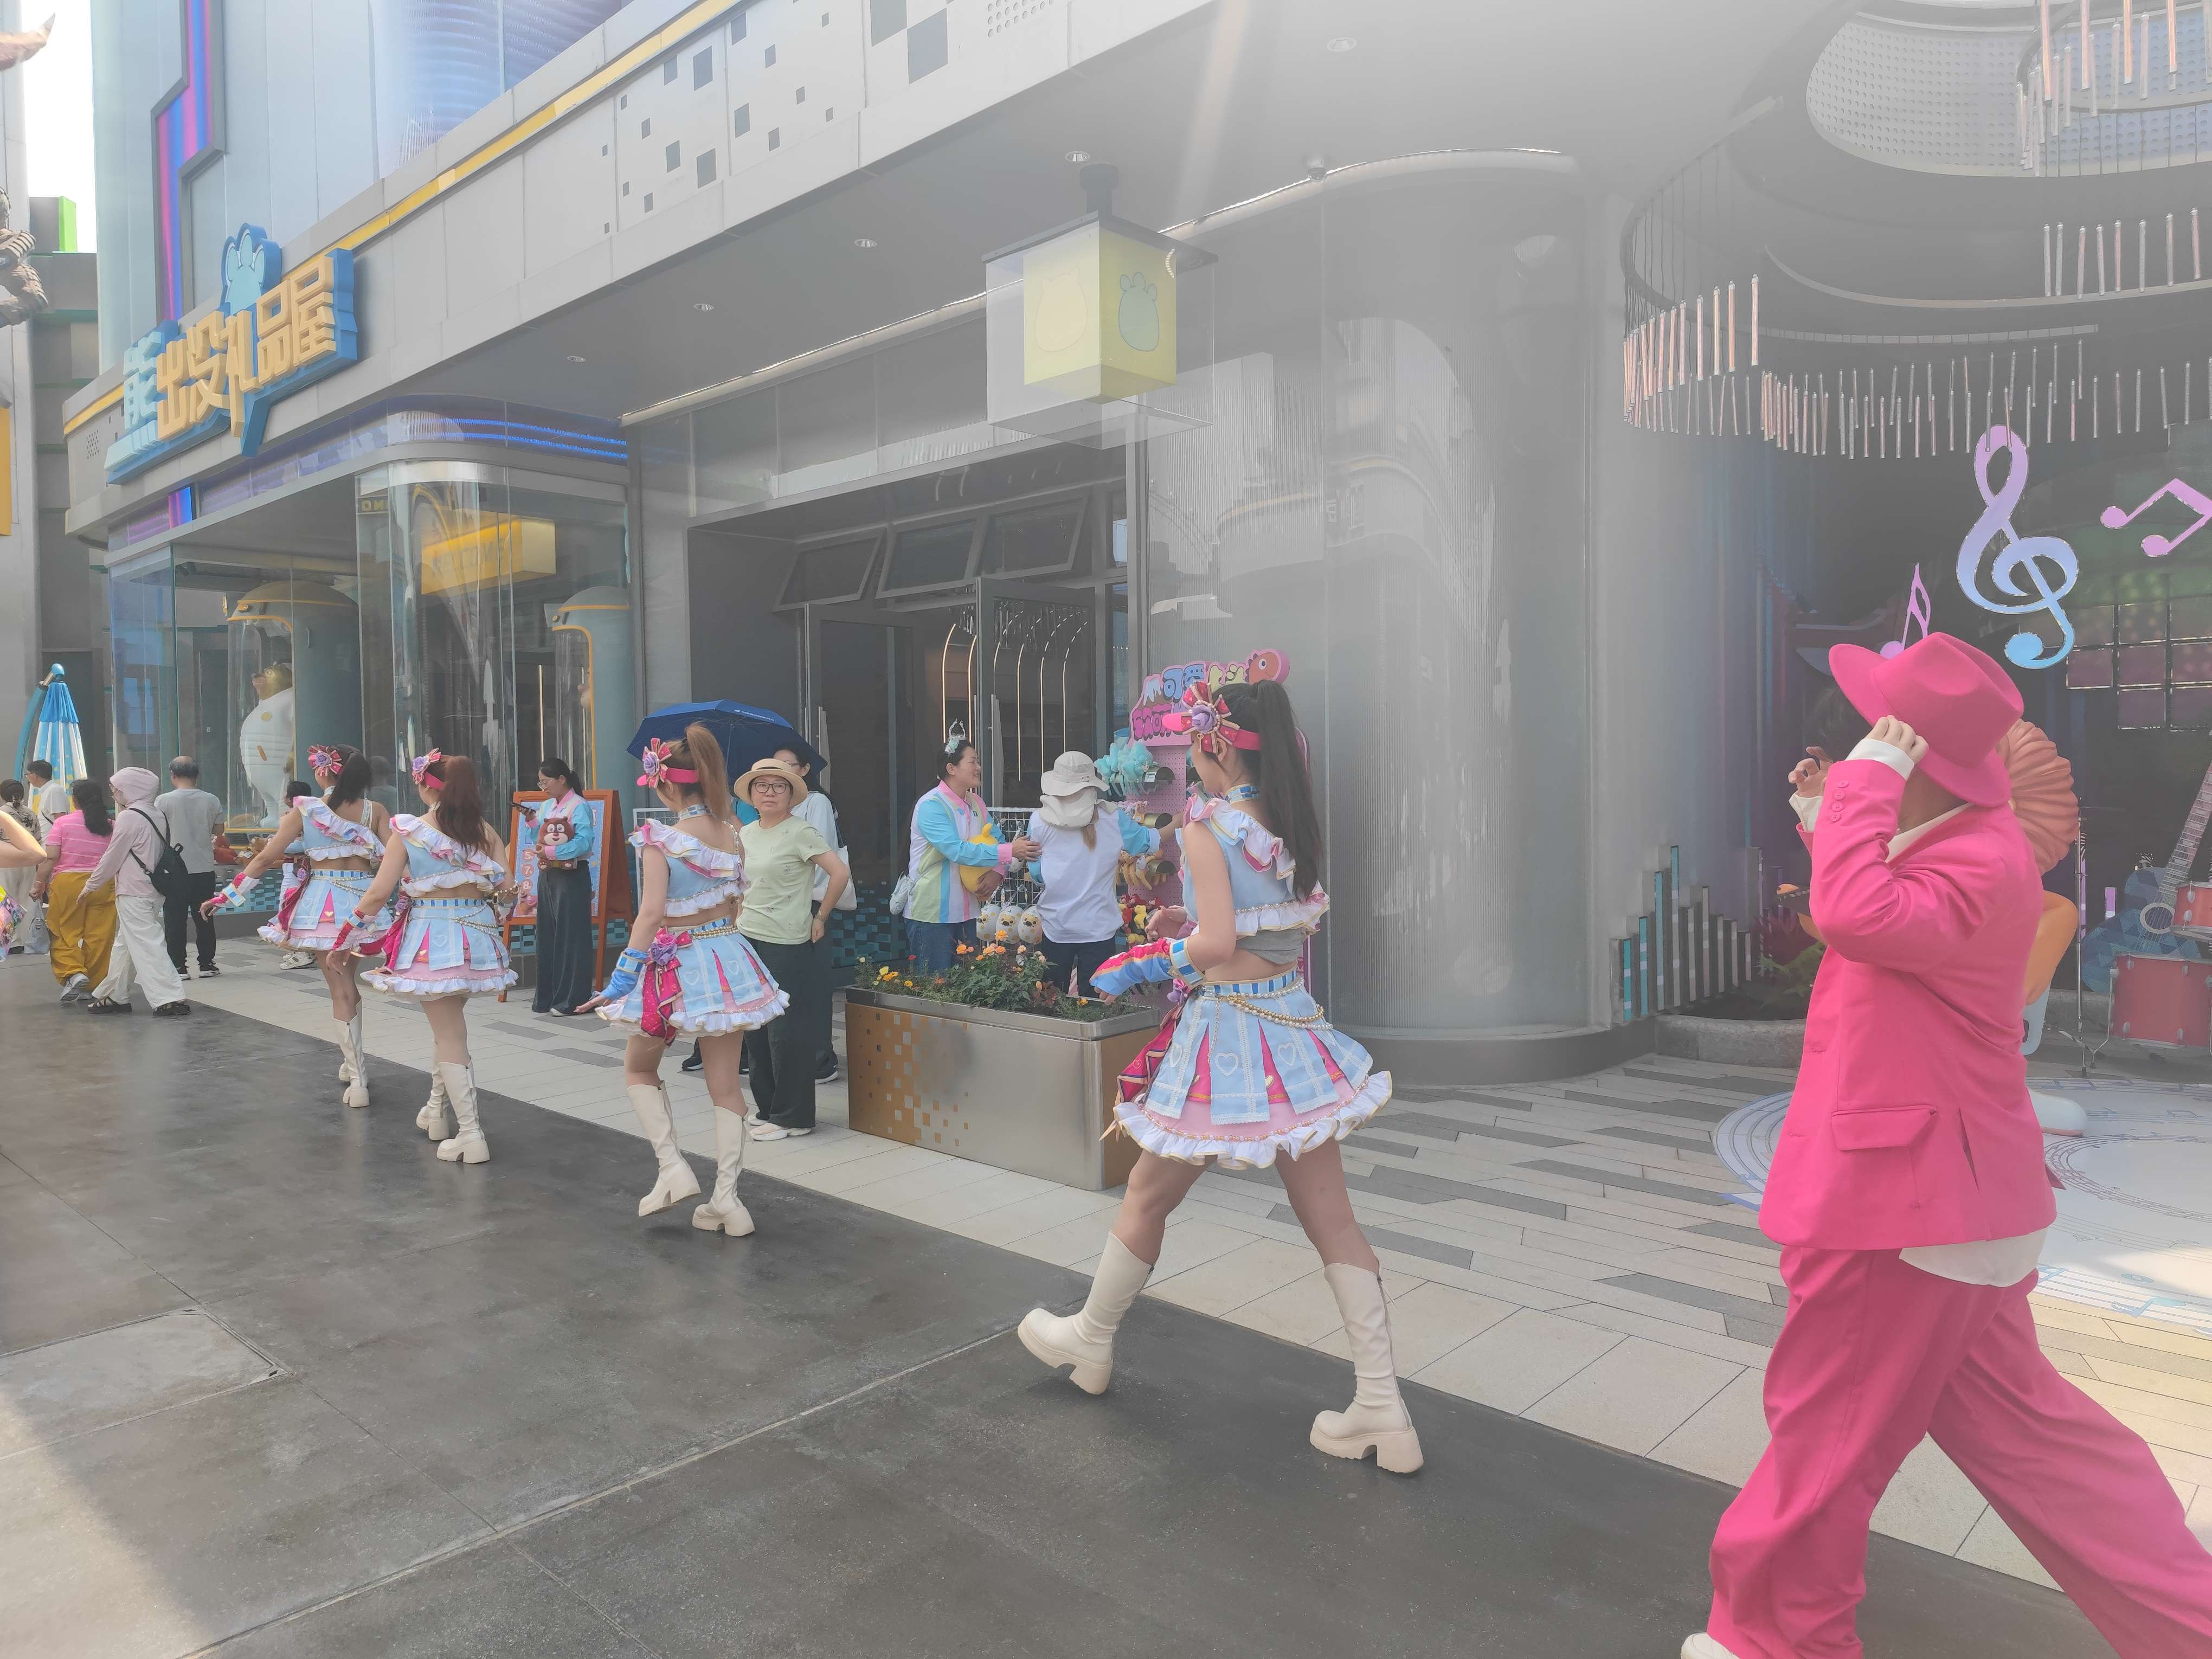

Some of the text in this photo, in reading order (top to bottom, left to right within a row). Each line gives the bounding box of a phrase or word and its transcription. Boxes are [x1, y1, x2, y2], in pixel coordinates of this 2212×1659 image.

[105, 255, 337, 473] 熊出没礼品屋
